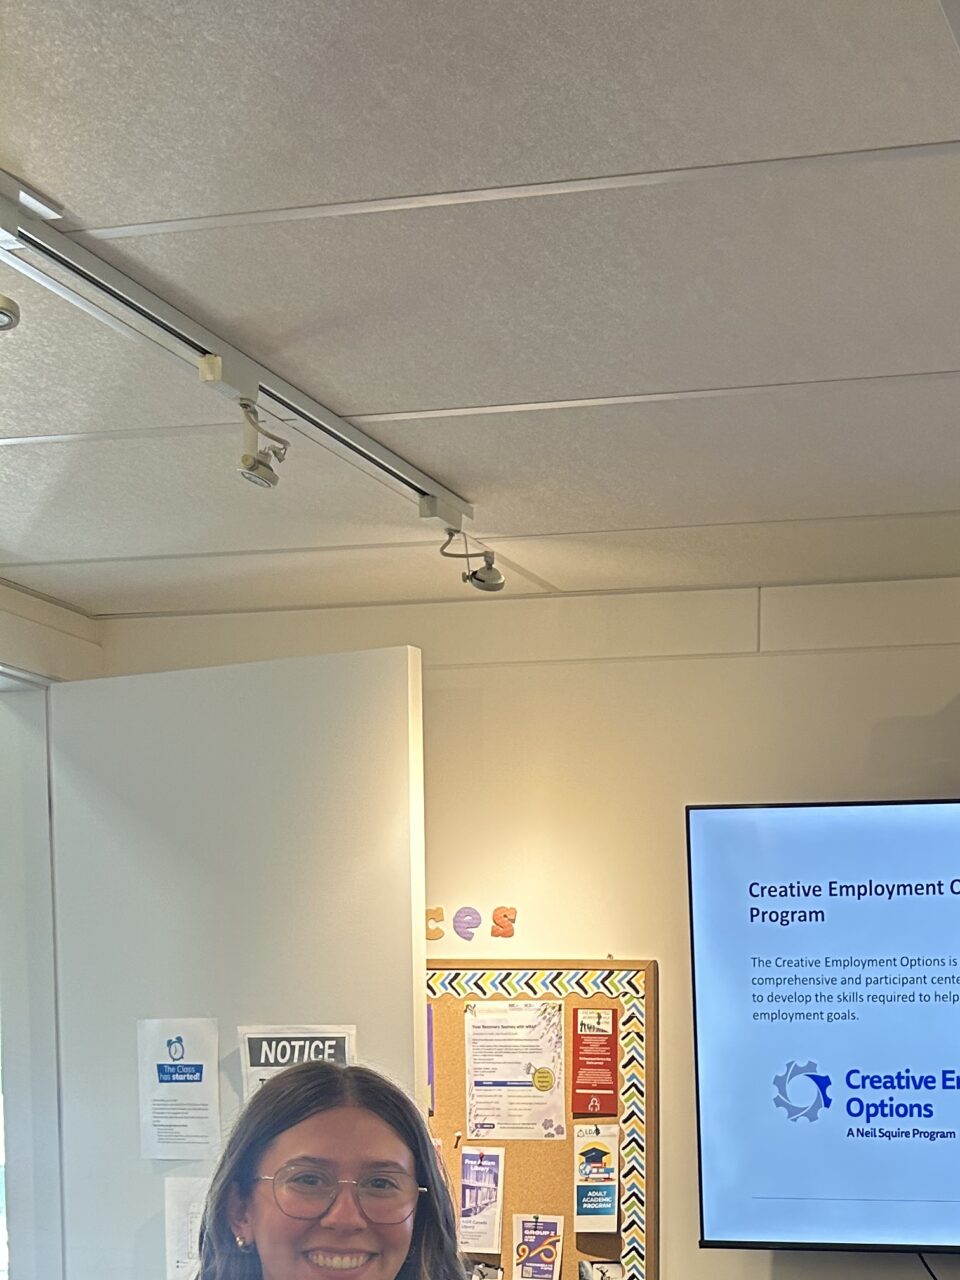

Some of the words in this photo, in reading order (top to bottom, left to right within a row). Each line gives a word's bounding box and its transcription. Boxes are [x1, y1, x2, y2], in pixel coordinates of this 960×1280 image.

[749, 881, 822, 898] Creative
[828, 879, 944, 900] Employment
[750, 906, 825, 926] Program
[751, 957, 772, 968] The
[775, 956, 821, 968] Creative
[825, 956, 897, 970] Employment
[900, 955, 946, 969] Options
[948, 956, 957, 967] is
[752, 973, 837, 988] comprehensive
[840, 973, 862, 985] and
[865, 973, 927, 988] participant
[752, 993, 764, 1003] to
[767, 991, 812, 1005] develop
[815, 991, 834, 1003] the
[837, 991, 864, 1003] skills
[866, 990, 915, 1005] required
[919, 992, 931, 1002] to
[934, 990, 960, 1005] help
[753, 1009, 824, 1023] employment
[827, 1009, 859, 1022] goals.
[260, 1040, 337, 1063] NOTICE
[845, 1069, 936, 1090] Creative
[846, 1097, 934, 1123] Options
[847, 1128, 855, 1138] A
[856, 1128, 877, 1138] Neil
[879, 1128, 910, 1140] Squire
[912, 1128, 956, 1141] Program
